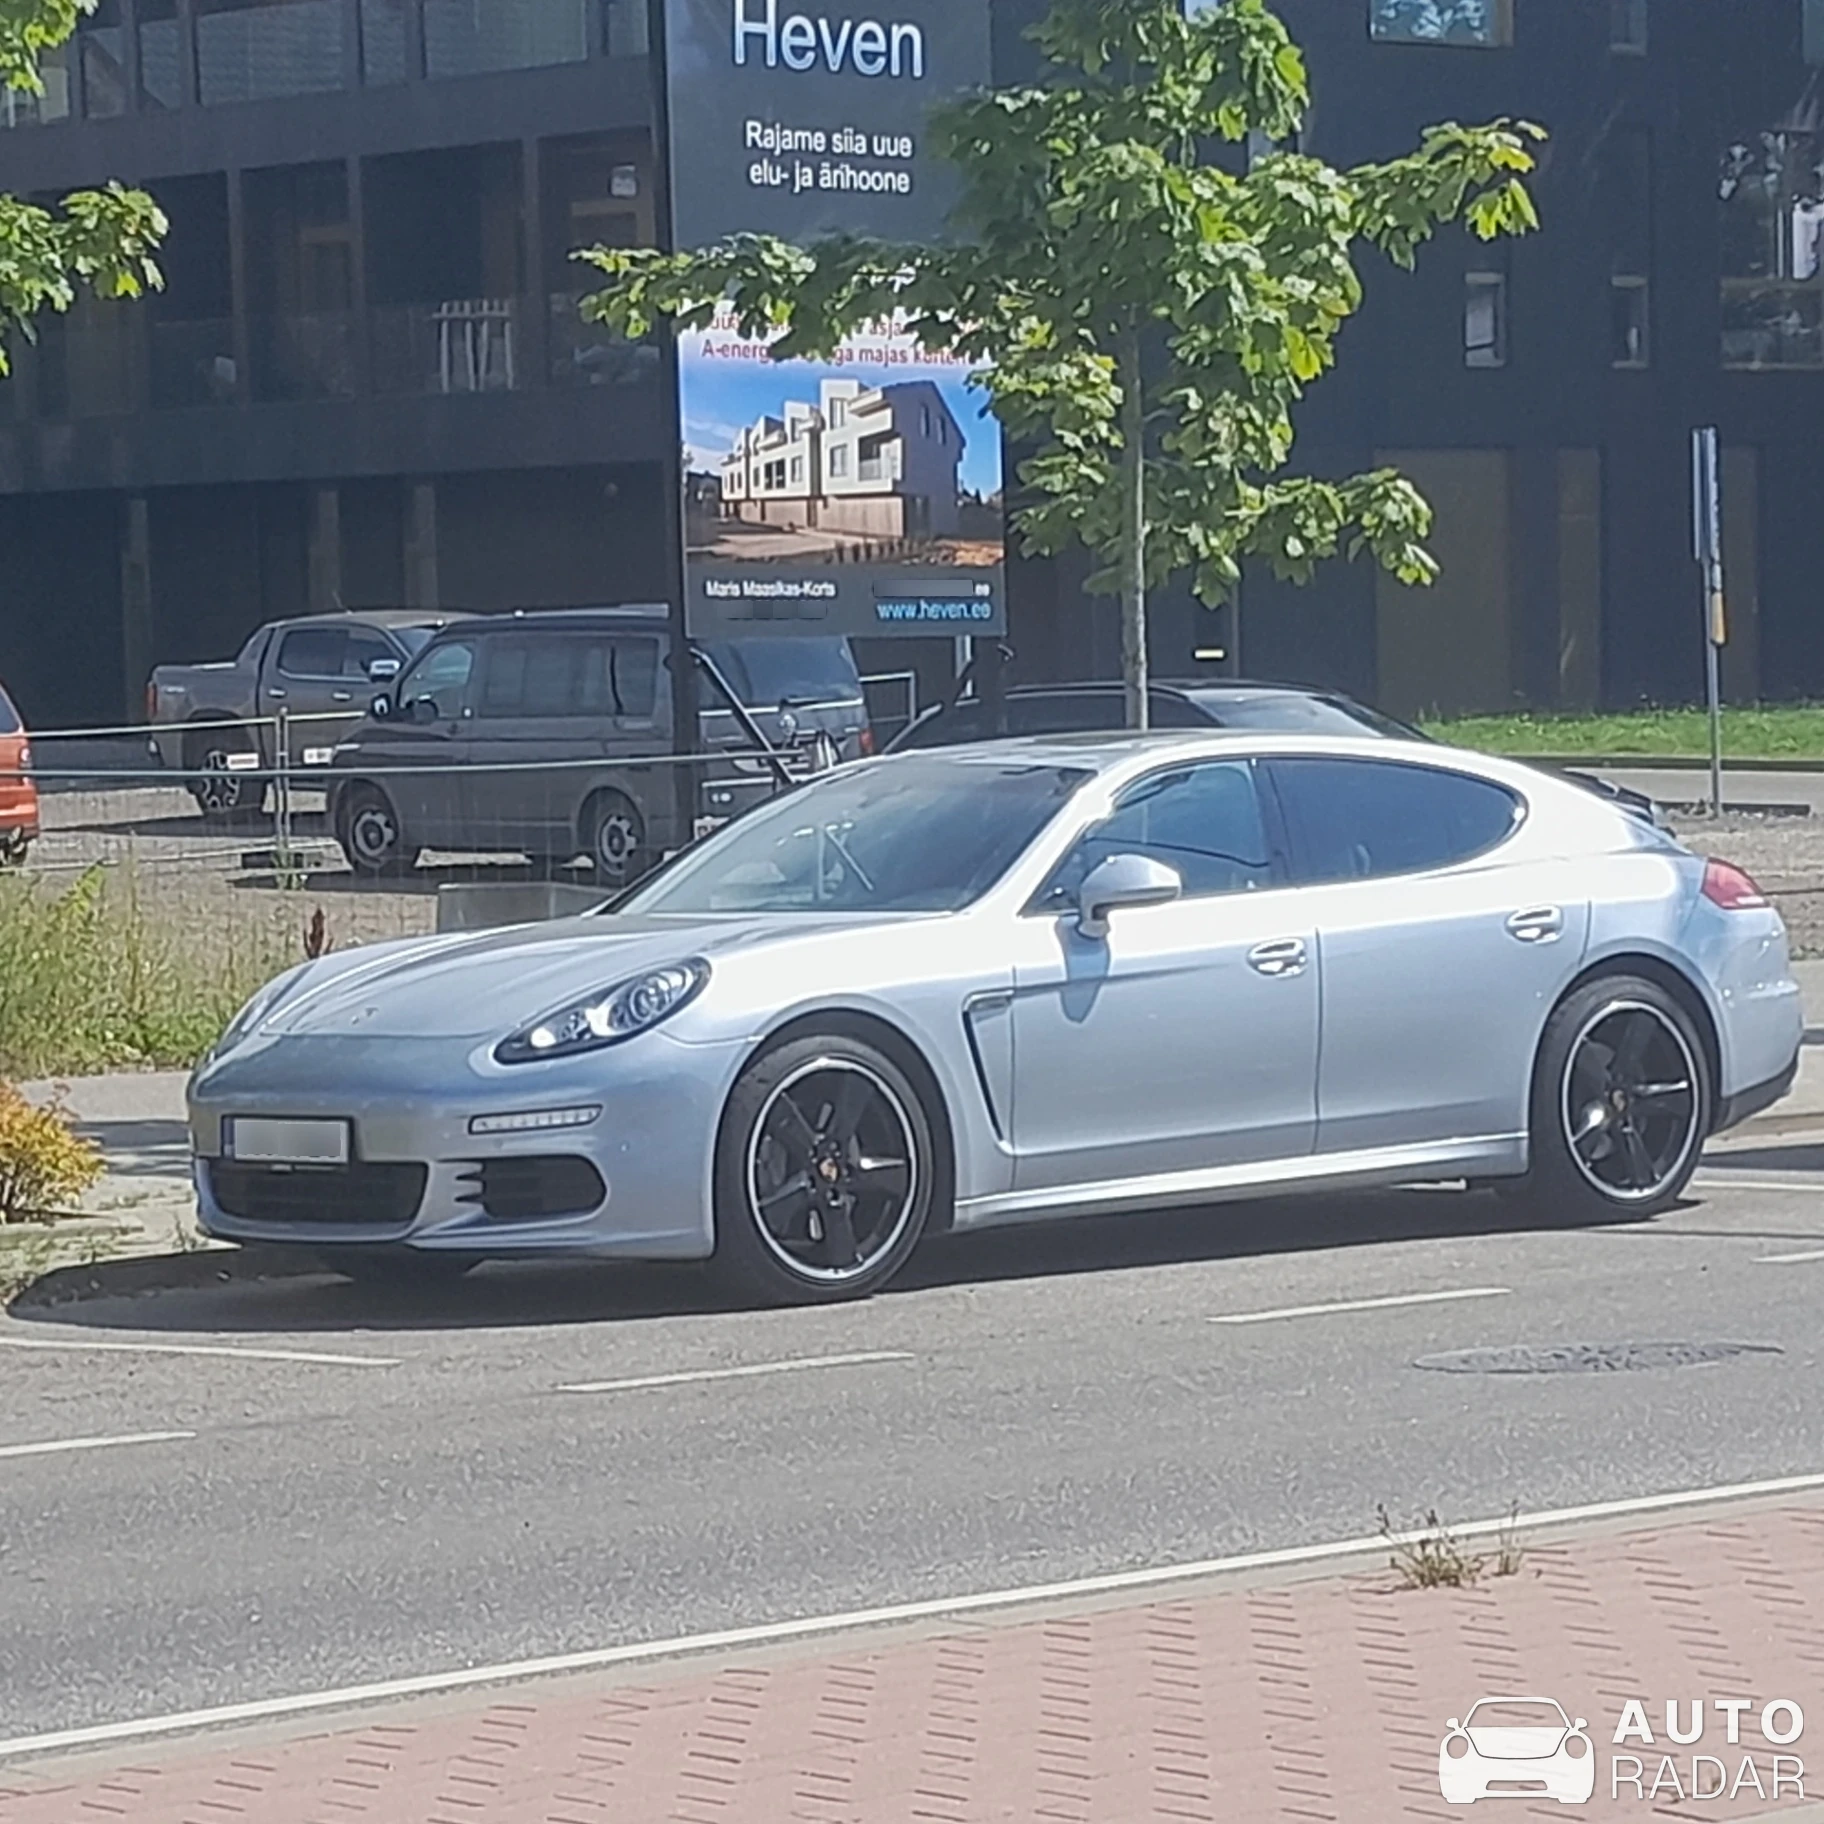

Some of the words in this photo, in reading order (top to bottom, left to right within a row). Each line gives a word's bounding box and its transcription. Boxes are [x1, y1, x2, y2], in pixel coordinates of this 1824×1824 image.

[733, 0, 924, 78] Heven
[745, 119, 826, 157] Rajame
[831, 126, 868, 155] siia
[872, 134, 913, 158] uue
[749, 157, 790, 185] elu-
[793, 160, 814, 194] ja
[858, 344, 909, 369] majas
[876, 599, 992, 620] www.heven.ee
